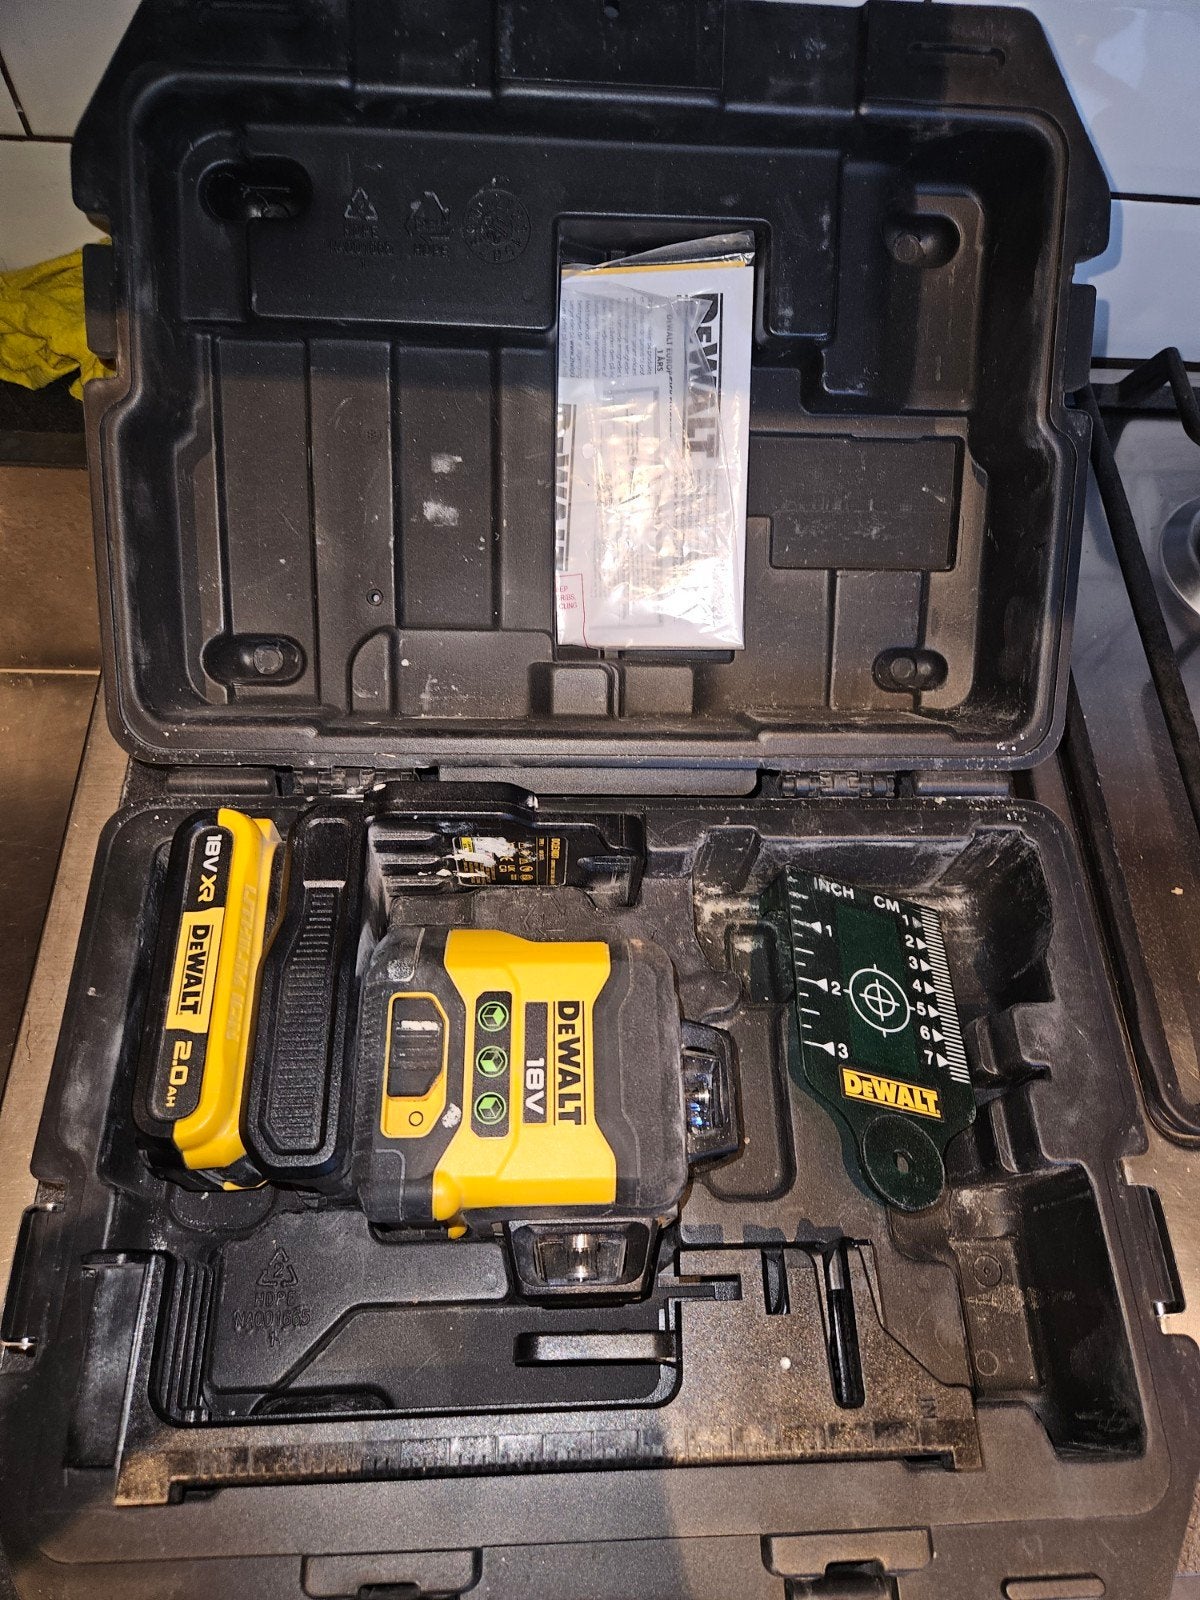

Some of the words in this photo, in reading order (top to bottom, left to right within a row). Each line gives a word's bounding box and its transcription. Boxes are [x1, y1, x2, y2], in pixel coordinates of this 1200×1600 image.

[656, 356, 664, 372] ÅRS
[688, 293, 719, 458] DEWALT
[202, 834, 223, 874] 18V
[197, 874, 219, 903] XR
[814, 876, 855, 900] INCH
[873, 895, 901, 914] CM
[902, 914, 910, 926] 1
[232, 884, 257, 987] LITHIUM
[825, 924, 833, 937] 1
[905, 936, 914, 948] 2
[179, 925, 210, 1016] DEWALT
[909, 956, 919, 970] 3
[831, 980, 842, 996] 2
[912, 978, 922, 993] 4
[917, 1001, 926, 1017] 5
[919, 1025, 930, 1041] 6
[838, 1042, 849, 1059] 3
[924, 1049, 934, 1066] 7
[556, 1000, 582, 1125] DEWALT
[525, 1057, 545, 1115] 18V
[844, 1074, 941, 1115] DEWALT
[273, 1262, 284, 1278] 2
[254, 1290, 298, 1308] HDPE
